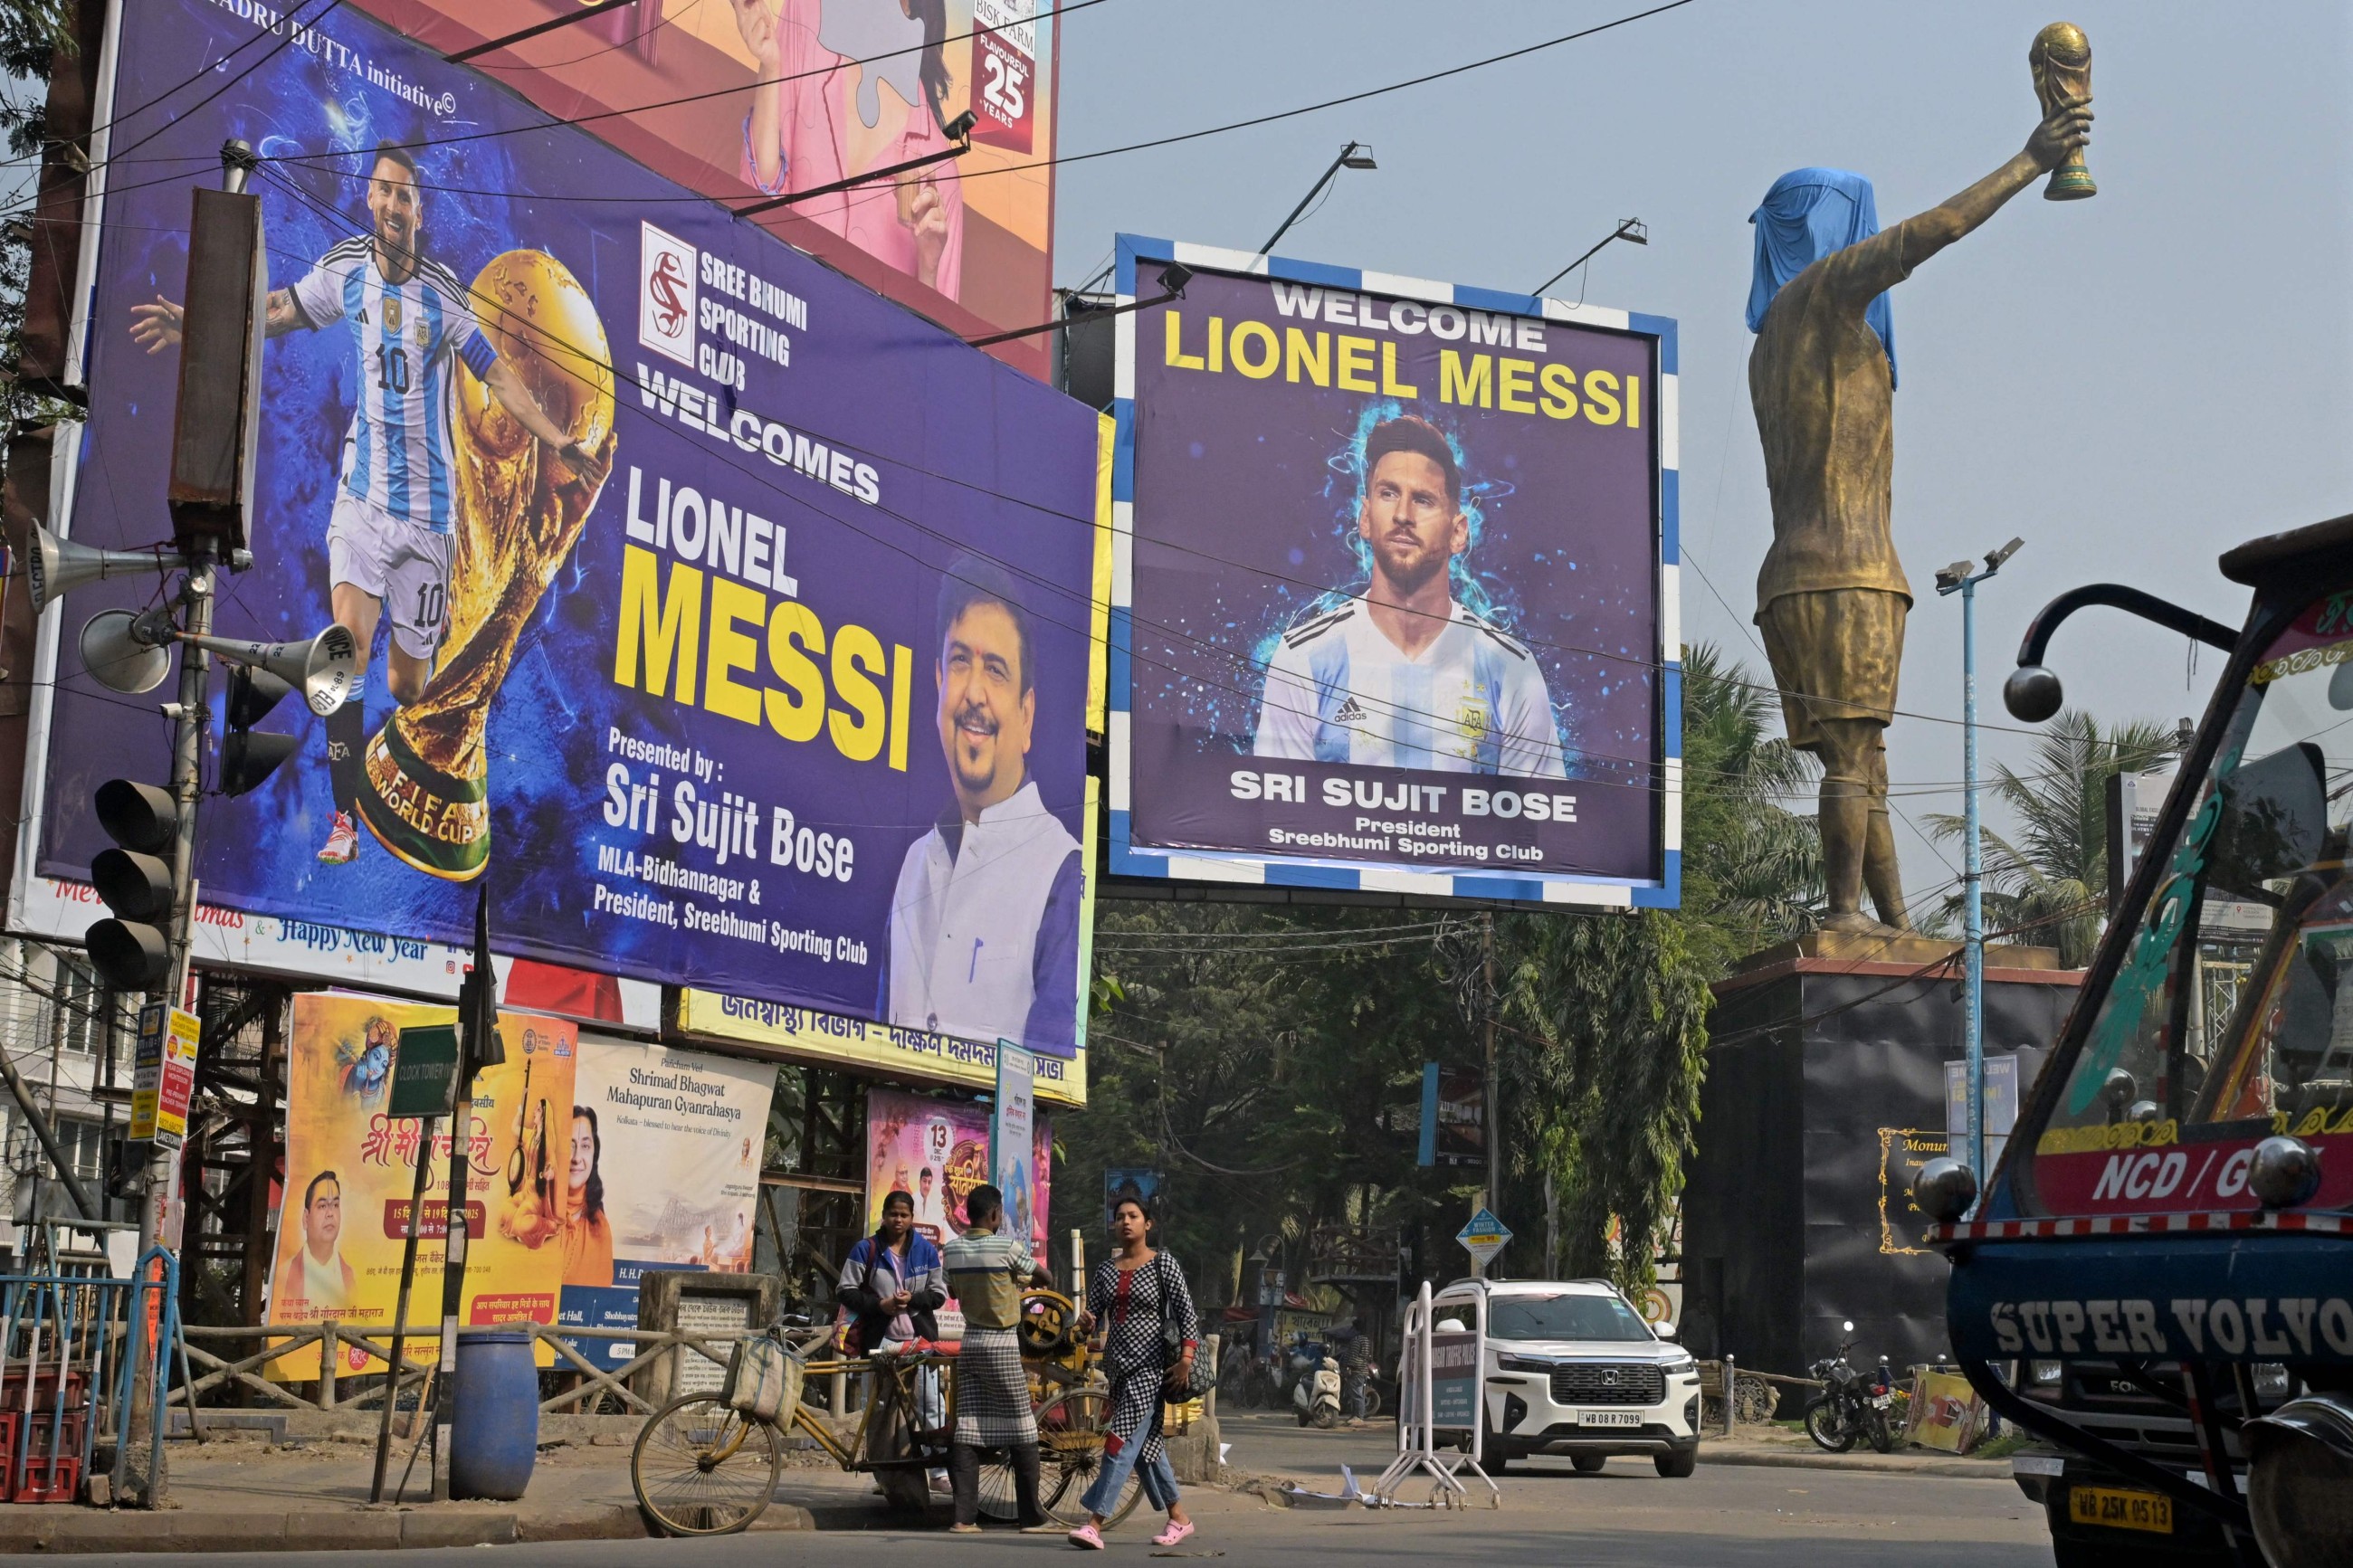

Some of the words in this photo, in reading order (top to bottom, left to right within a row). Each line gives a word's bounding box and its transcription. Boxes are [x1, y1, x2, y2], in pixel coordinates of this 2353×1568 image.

[209, 0, 284, 35] ADRU
[291, 19, 363, 77] DUTTA
[976, 0, 1001, 28] BISK
[1003, 15, 1034, 52] FARM
[980, 33, 1030, 79] FLAVOURFUL
[984, 53, 1024, 119] 25
[983, 100, 1013, 129] YEARS
[700, 252, 746, 302] SREE
[749, 274, 807, 332] BHUMI
[1271, 281, 1548, 353] WELCOME
[700, 297, 790, 367] SPORTING
[375, 343, 410, 394] 10
[699, 343, 746, 391] CLUB
[1166, 310, 1418, 399] LIONEL
[1440, 350, 1640, 429] MESSI
[637, 362, 880, 505] WELCOMES
[626, 465, 798, 598] LIONEL
[414, 582, 445, 629] 10
[614, 543, 912, 772] MESSI
[1334, 710, 1367, 723] adidas
[608, 727, 690, 774] Presented
[695, 751, 714, 784] by
[376, 780, 433, 834] WORLD
[437, 821, 474, 846] CUP
[394, 771, 461, 821] FIFA
[1230, 771, 1306, 803] SRI
[1322, 777, 1447, 813] SUJIT
[1462, 788, 1577, 822] BOSE
[604, 762, 660, 834] Sri
[672, 780, 759, 865] Sujit
[770, 806, 854, 883] Bose
[1269, 828, 1390, 851] Sreebhumi
[1397, 836, 1489, 860] Sporting
[1496, 843, 1544, 860] Club
[1356, 817, 1461, 838] President
[598, 844, 745, 903] MLA-Bidhannagar
[749, 879, 761, 905] &
[277, 917, 341, 951] Happy
[343, 928, 386, 954] New
[386, 936, 429, 963] Year
[594, 884, 679, 930] President,
[684, 901, 767, 944] Sreebhumi
[771, 921, 832, 964] Sporting
[836, 935, 869, 965] Club
[399, 1063, 421, 1081] CLOCK
[421, 1062, 443, 1080] TOWER
[629, 1067, 678, 1090] Shrimad
[680, 1075, 726, 1098] Bhagwat
[691, 1062, 703, 1073] Ved
[606, 1086, 672, 1111] Mahapuran
[674, 1096, 741, 1123] Gyanrahasya
[616, 1114, 639, 1126] Kolkata
[643, 1117, 664, 1130] blessed
[664, 1122, 672, 1131] to
[671, 1123, 683, 1132] hear
[683, 1124, 693, 1134] the
[693, 1126, 707, 1135] voice
[712, 1127, 731, 1140] Divinity
[157, 1129, 182, 1146] LAKETOWN
[930, 1124, 948, 1148] 13
[2092, 1150, 2187, 1200] NCD
[567, 1309, 585, 1324] Hall,
[1991, 1300, 2167, 1353] SUPER
[2172, 1297, 2353, 1356] VOLVO
[1586, 1413, 1596, 1424] WB
[1598, 1413, 1609, 1424] 08
[1611, 1413, 1616, 1424] R
[1618, 1414, 1640, 1424] 7099
[2101, 1496, 2129, 1521] 25K
